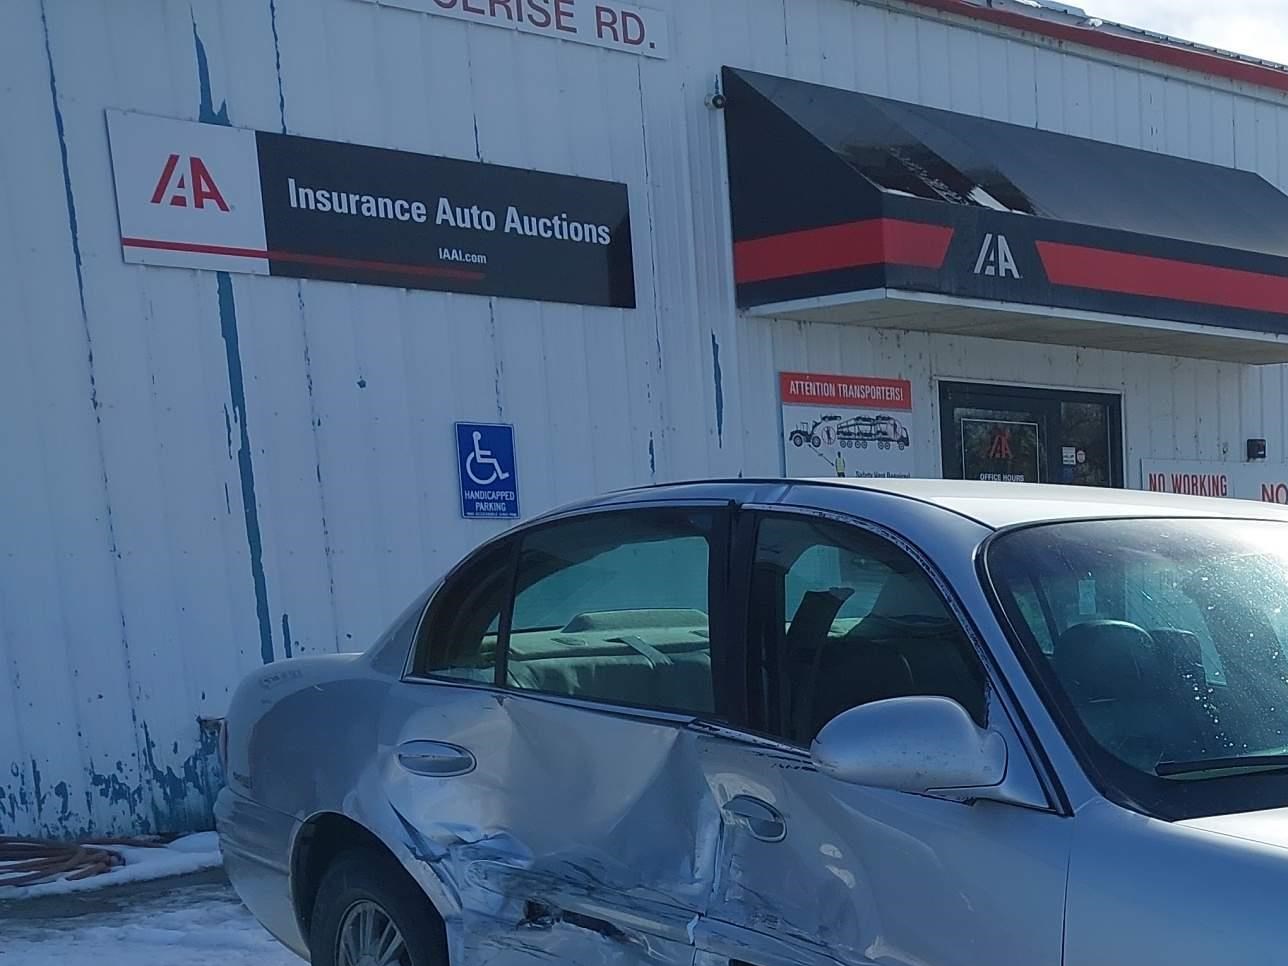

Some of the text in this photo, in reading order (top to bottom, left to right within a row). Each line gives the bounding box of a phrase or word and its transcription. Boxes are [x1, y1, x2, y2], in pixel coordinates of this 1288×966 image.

[432, 0, 657, 49] RISE RD.
[287, 177, 612, 246] Insurance Auto Auctions
[437, 247, 488, 265] IAAI.com
[789, 380, 904, 401] ATTENTION TRANSPORTERS!
[979, 472, 1025, 483] OFFICE HOURS
[1148, 472, 1228, 497] NO WORKING
[464, 489, 516, 501] HANDICAPPED
[475, 501, 507, 512] PARKING
